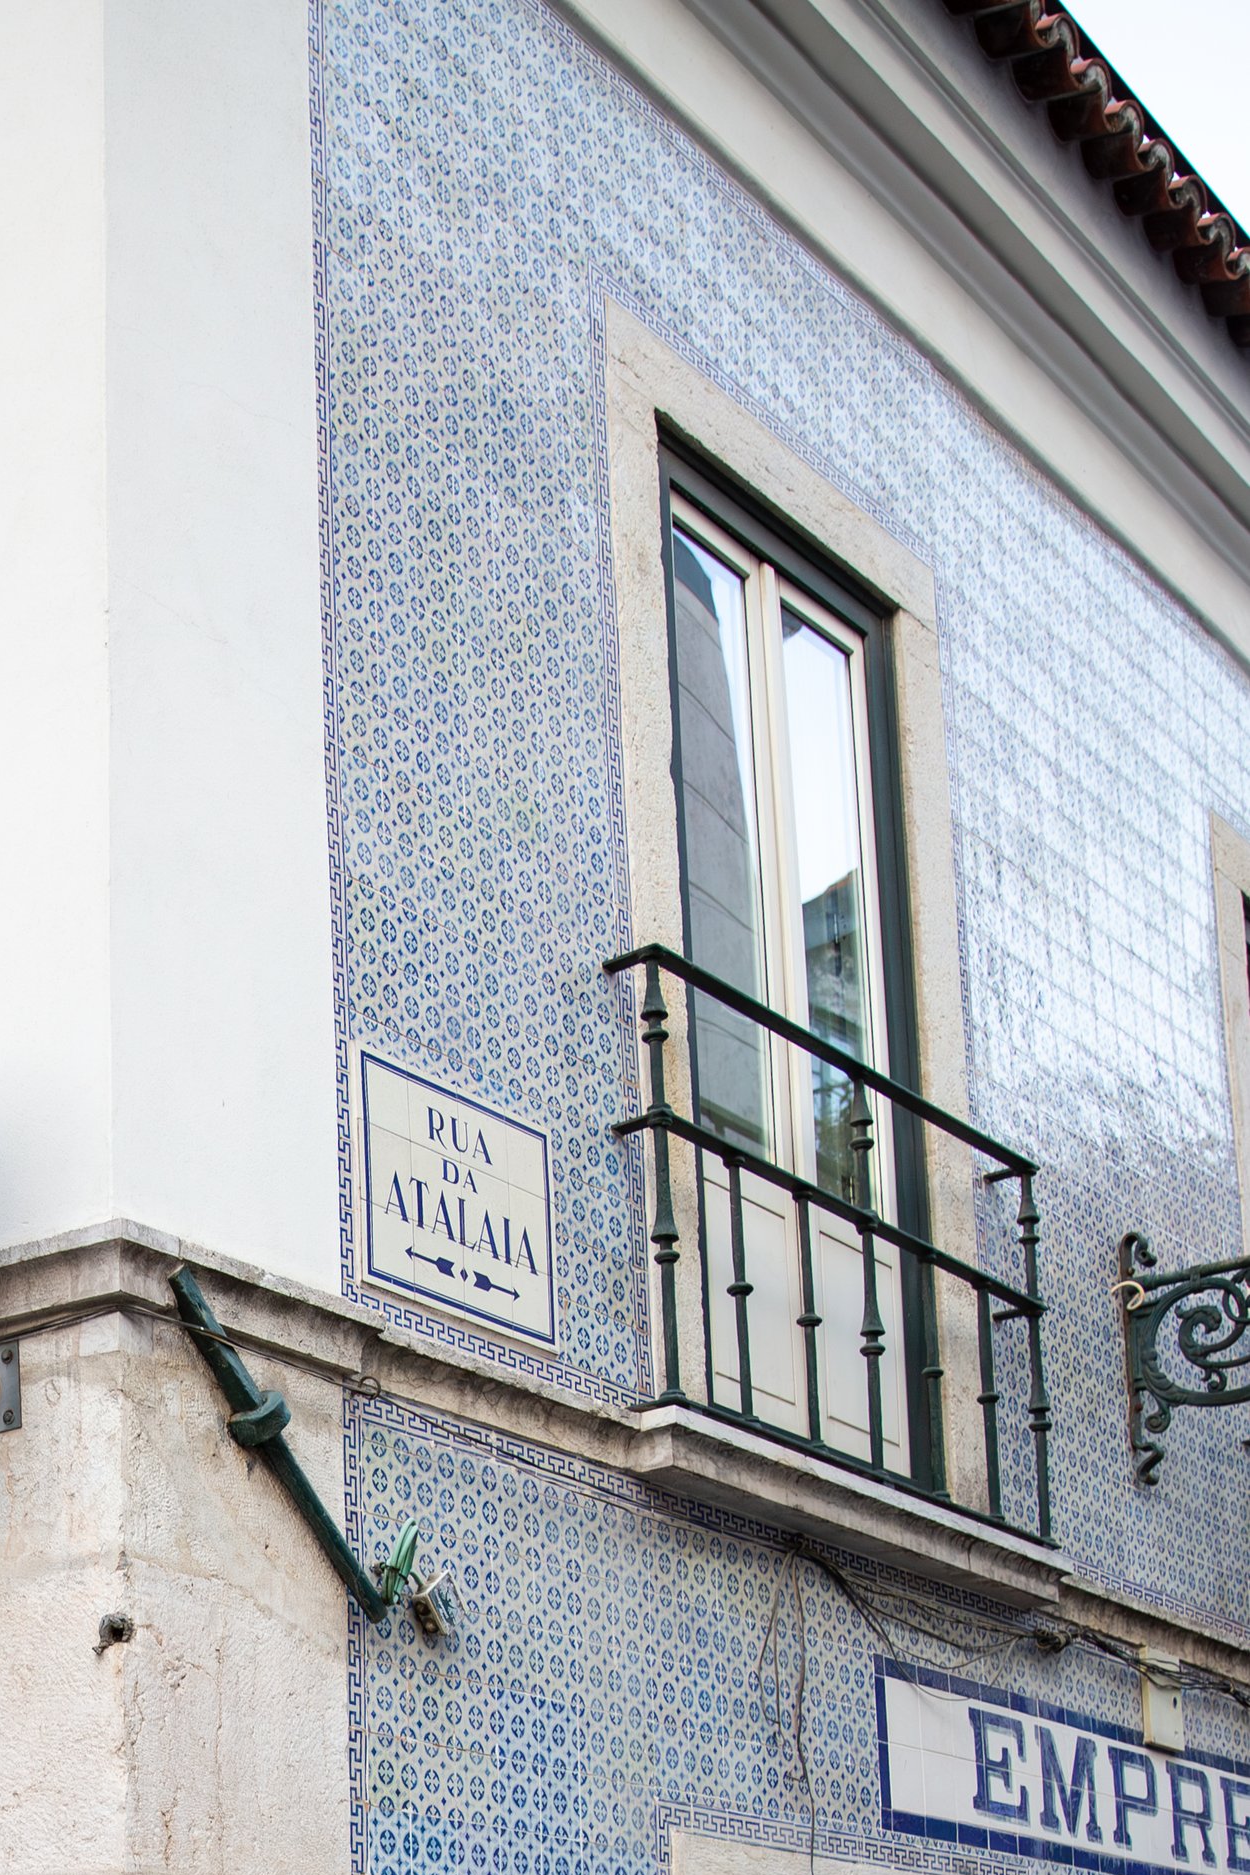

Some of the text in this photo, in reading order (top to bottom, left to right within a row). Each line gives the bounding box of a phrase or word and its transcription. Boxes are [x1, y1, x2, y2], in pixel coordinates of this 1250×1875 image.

[426, 1105, 494, 1167] RUA
[441, 1157, 479, 1196] DA
[383, 1169, 540, 1278] ATALAIA
